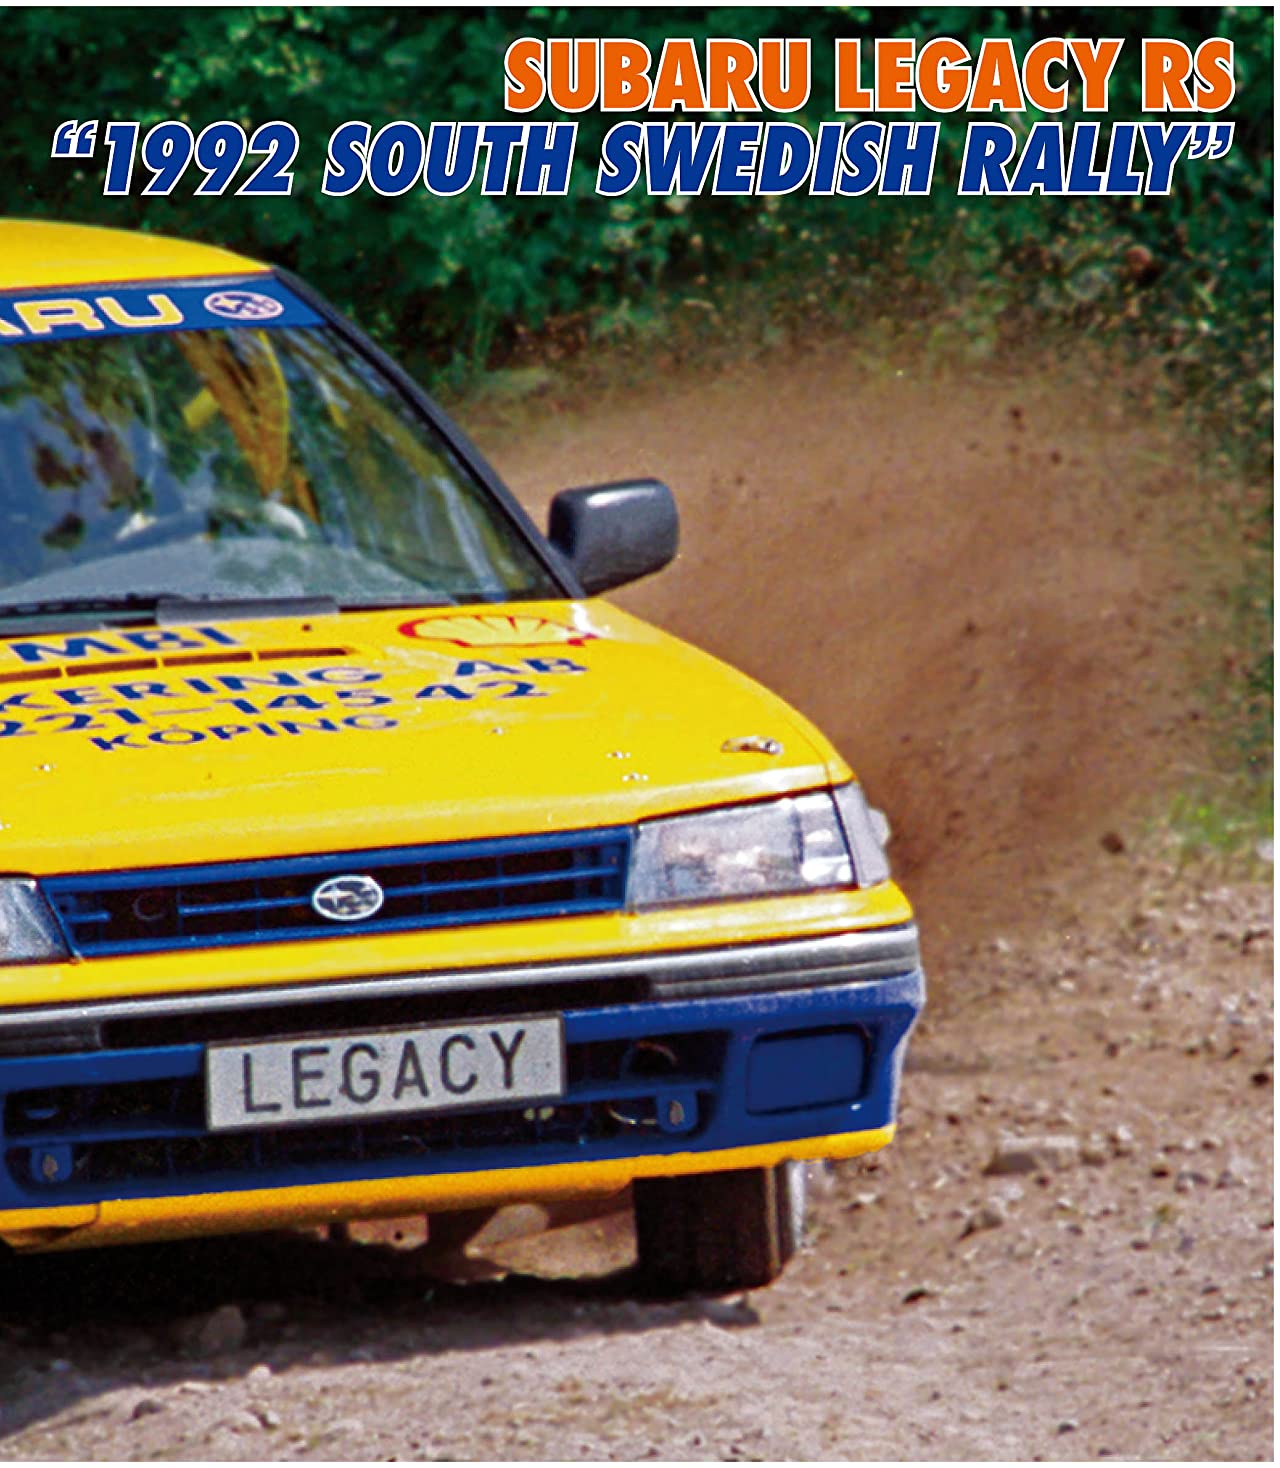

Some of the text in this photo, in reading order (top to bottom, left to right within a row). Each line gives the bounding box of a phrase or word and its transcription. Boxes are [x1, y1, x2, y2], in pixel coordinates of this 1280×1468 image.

[7, 625, 245, 664] MBI
[454, 657, 589, 678] AB
[241, 1028, 527, 1115] LEGACY
